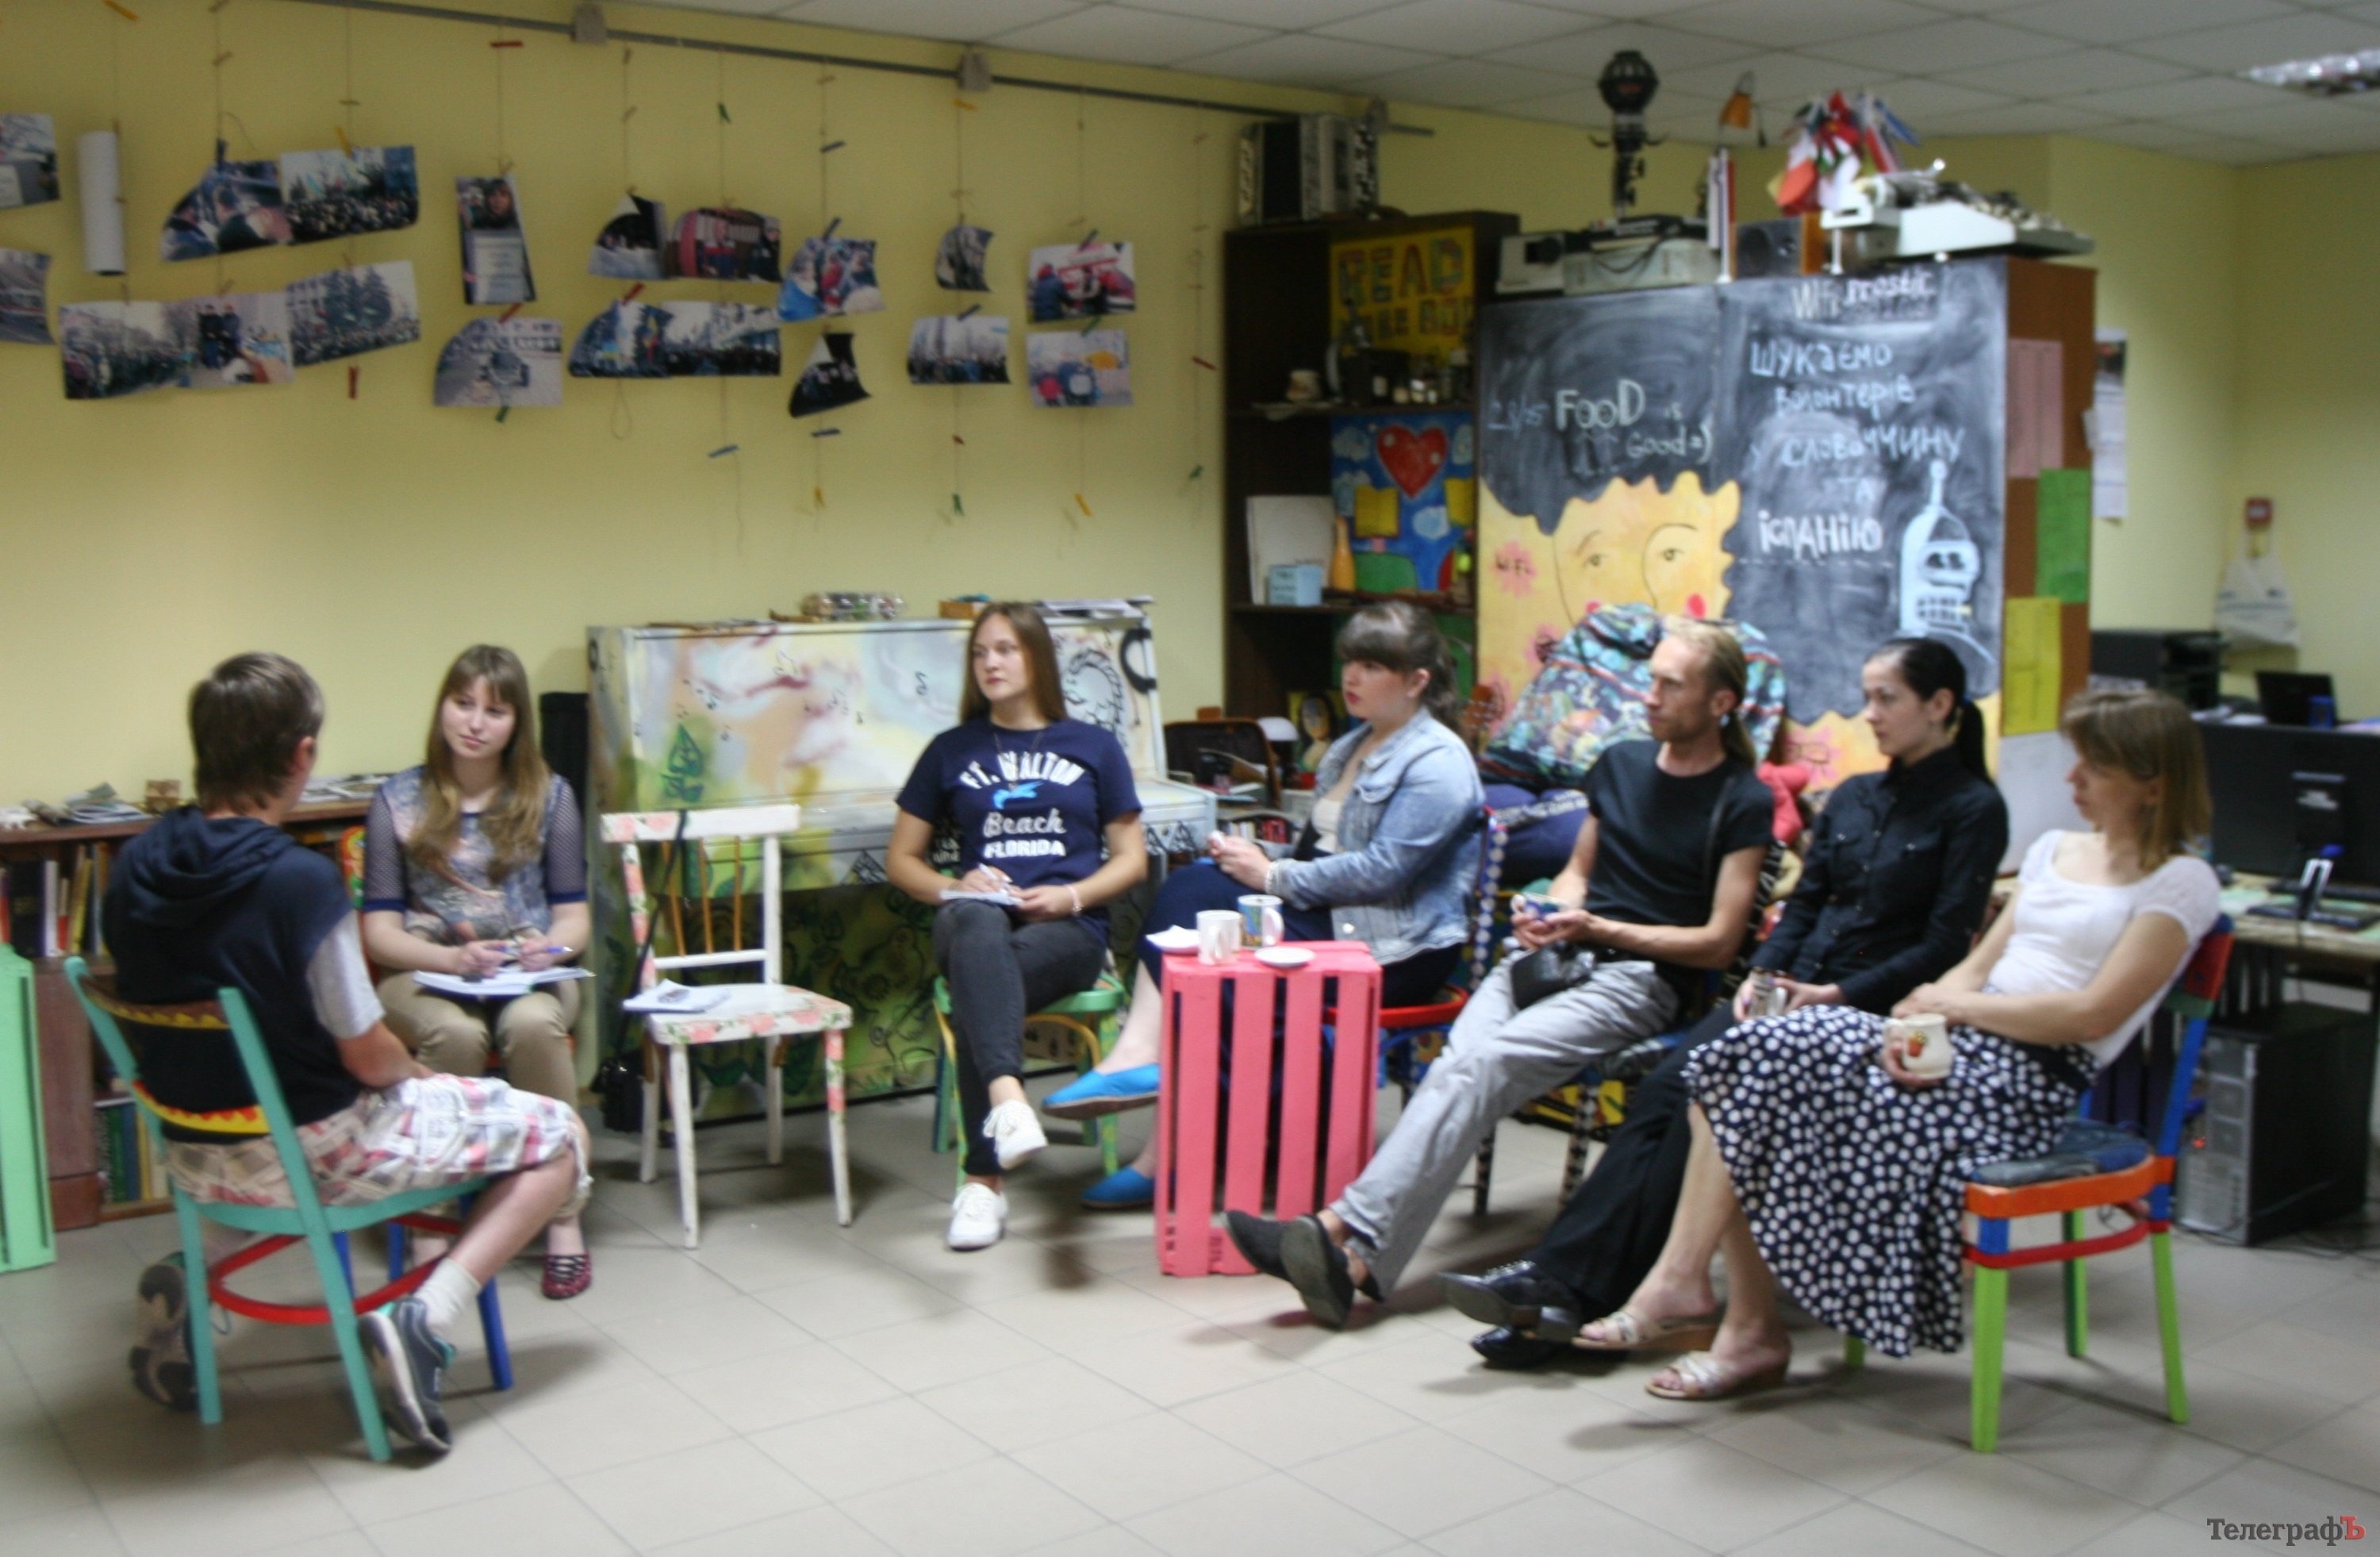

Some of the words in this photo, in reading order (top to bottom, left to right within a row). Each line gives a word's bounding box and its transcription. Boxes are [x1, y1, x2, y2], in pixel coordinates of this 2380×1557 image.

[958, 759, 1001, 790] FT.
[996, 750, 1086, 786] WALTON
[982, 806, 1068, 838] Beach
[982, 838, 1067, 859] FLORIDA
